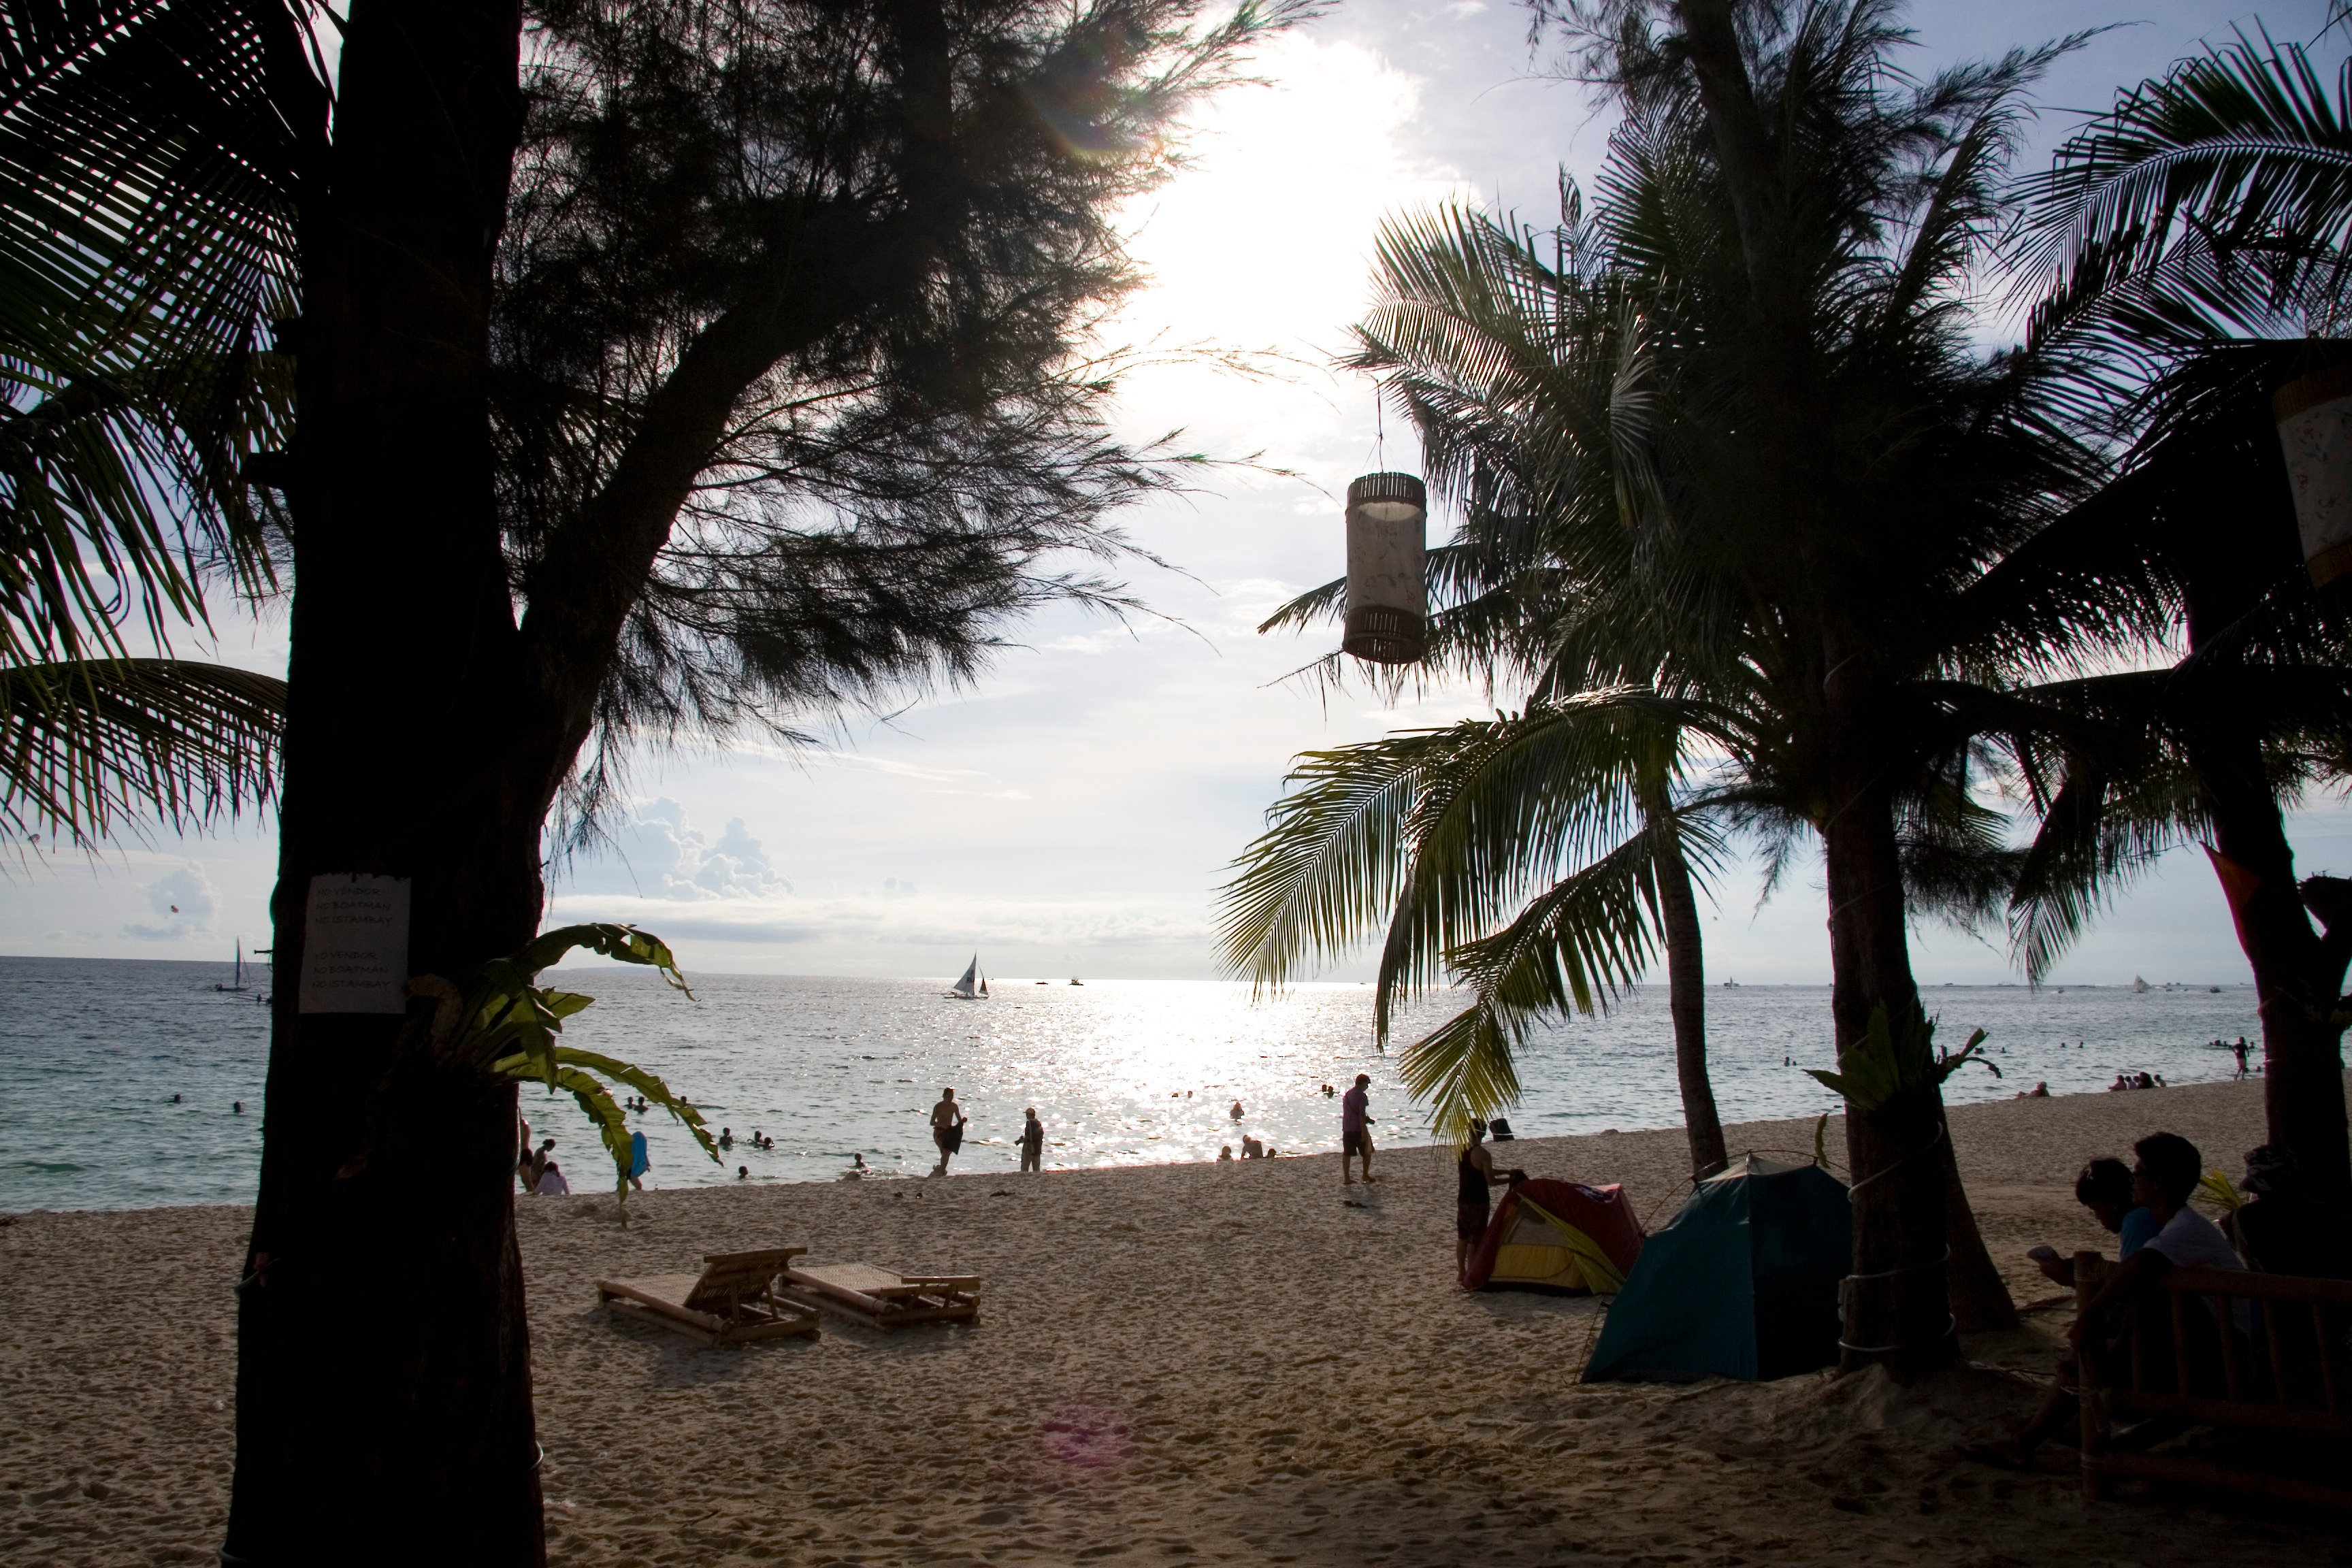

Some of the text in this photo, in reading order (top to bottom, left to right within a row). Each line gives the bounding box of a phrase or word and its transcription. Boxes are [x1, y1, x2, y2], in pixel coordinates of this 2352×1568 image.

[317, 887, 381, 896] NO VENDOR
[332, 901, 391, 911] BOATMAN
[331, 951, 378, 960] VENDOR
[329, 966, 388, 974] BOATMAN
[312, 981, 327, 989] NO
